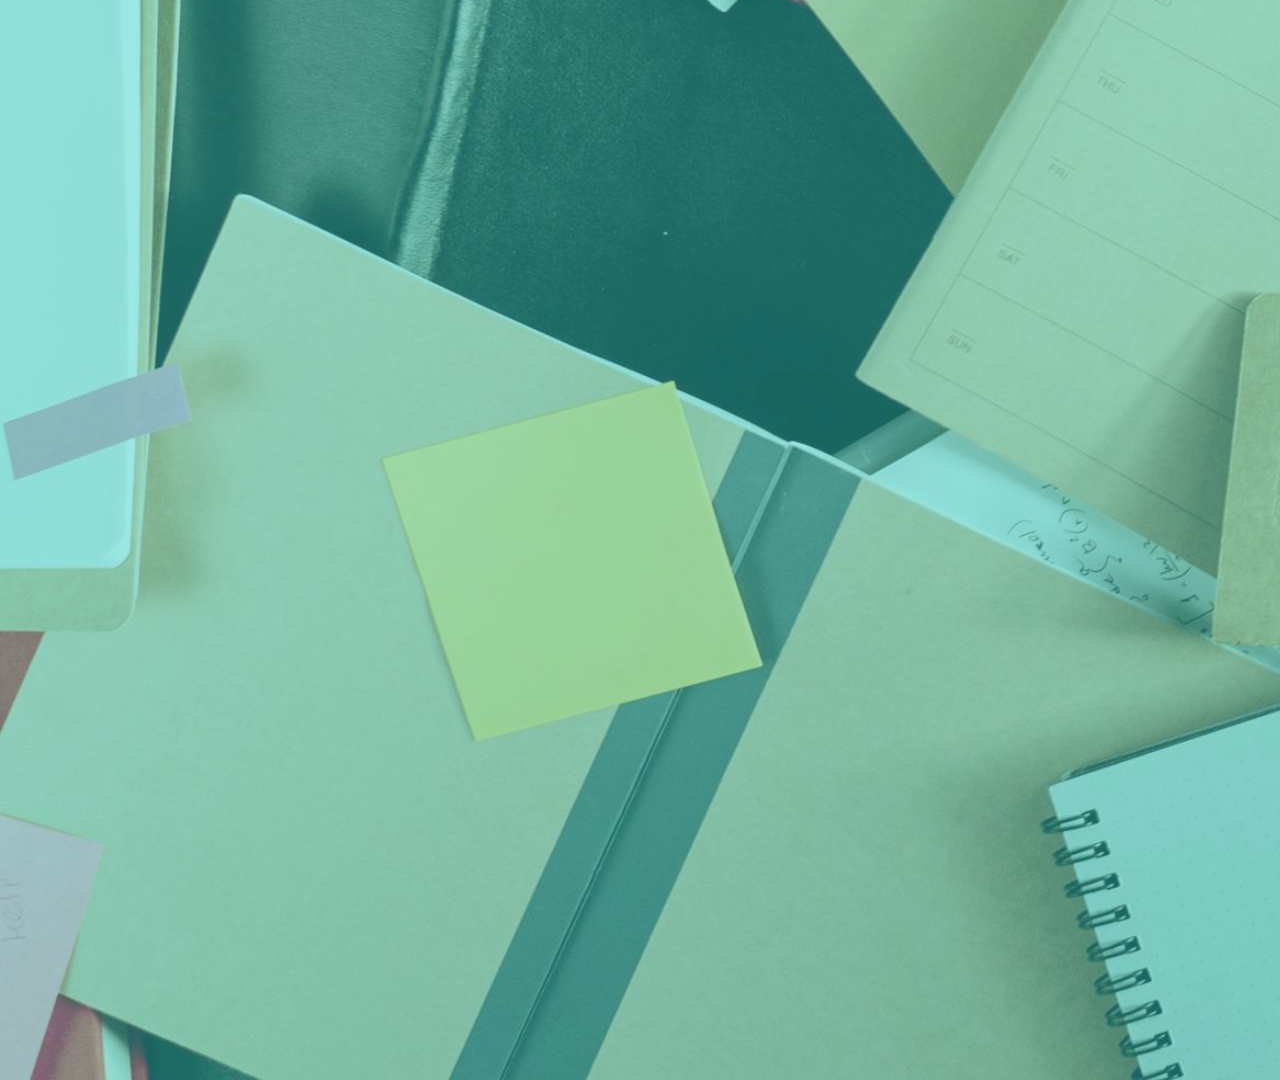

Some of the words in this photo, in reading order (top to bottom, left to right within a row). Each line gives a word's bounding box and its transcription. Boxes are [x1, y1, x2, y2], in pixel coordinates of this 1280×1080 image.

[1097, 75, 1121, 95] THU
[1048, 162, 1069, 180] FRI
[997, 248, 1021, 266] SAT
[947, 334, 972, 354] SUN
